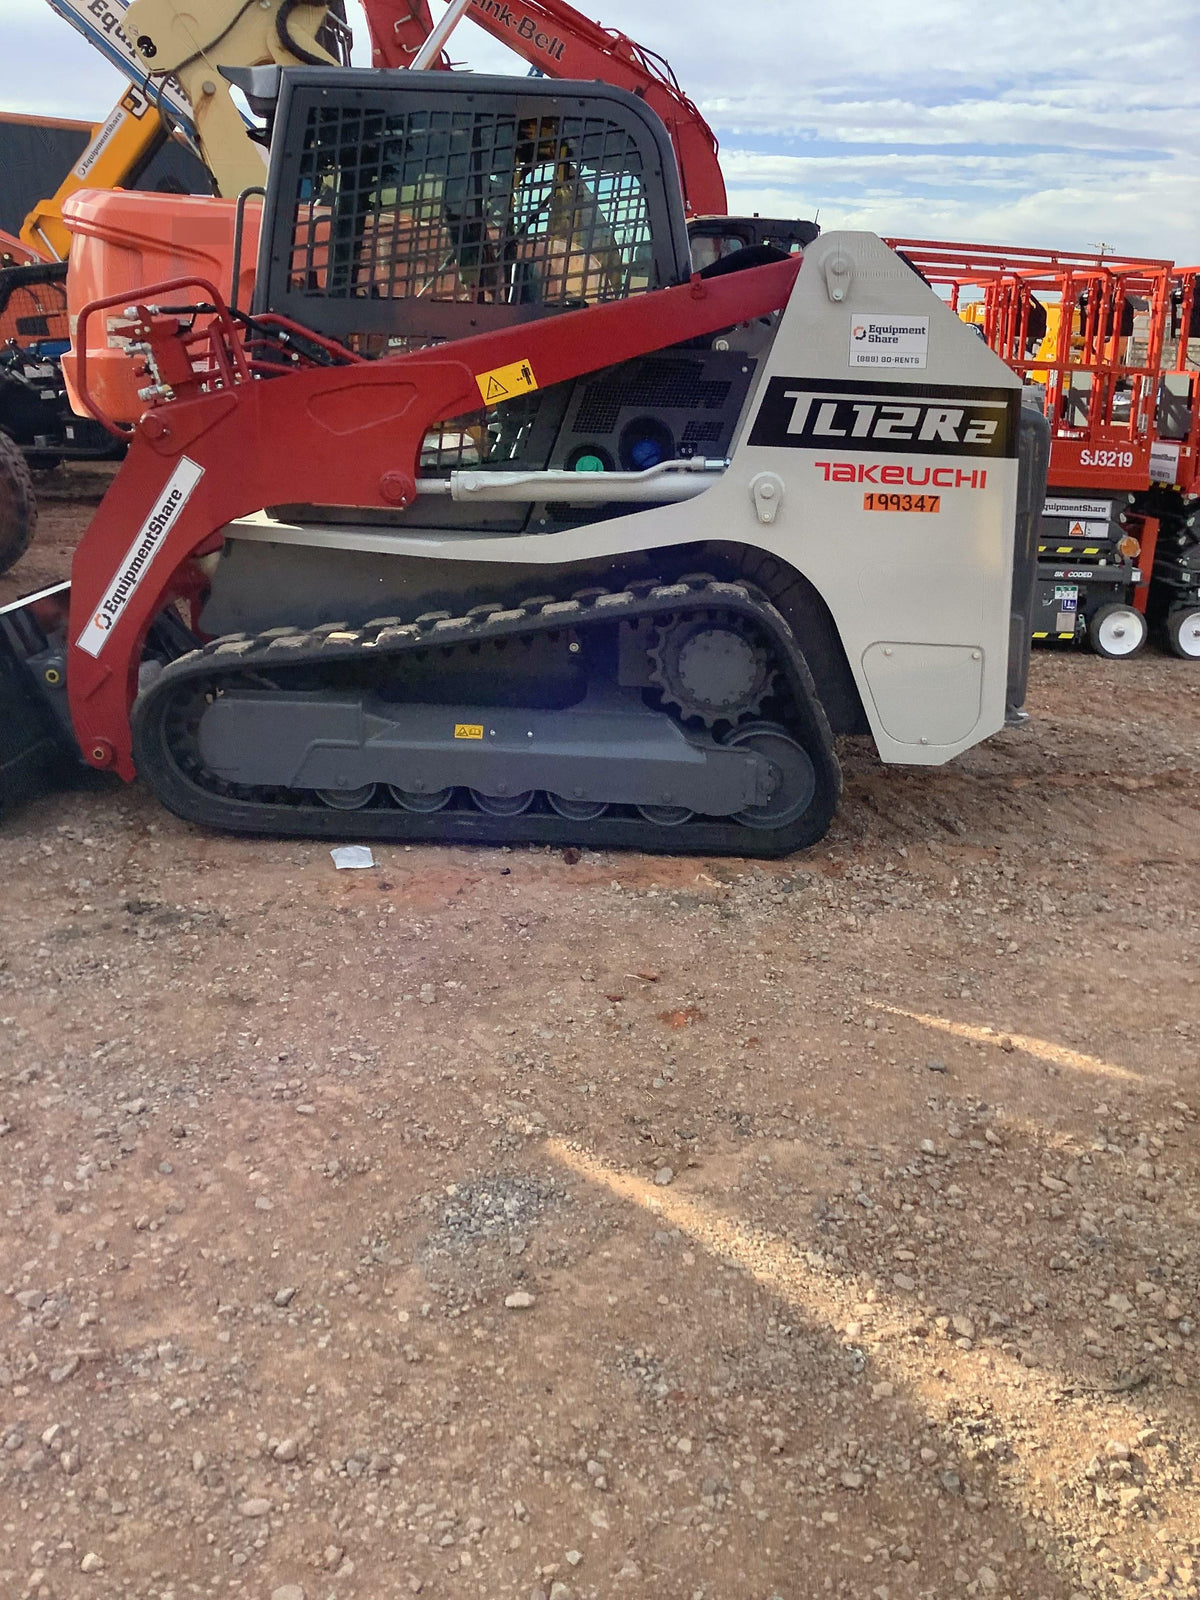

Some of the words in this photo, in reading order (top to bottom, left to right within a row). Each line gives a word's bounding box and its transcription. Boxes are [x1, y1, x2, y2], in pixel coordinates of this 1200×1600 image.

[470, 0, 566, 61] ink-Belt
[82, 112, 123, 169] EquipmentShare
[867, 334, 899, 344] Share
[868, 324, 926, 336] Equipment
[857, 355, 879, 363] (888)
[784, 391, 1008, 444] TL12R2
[1080, 449, 1133, 468] SJ3219
[866, 493, 940, 512] 199347
[1043, 503, 1107, 513] quipmentShare
[103, 488, 183, 616] EquipmentShare
